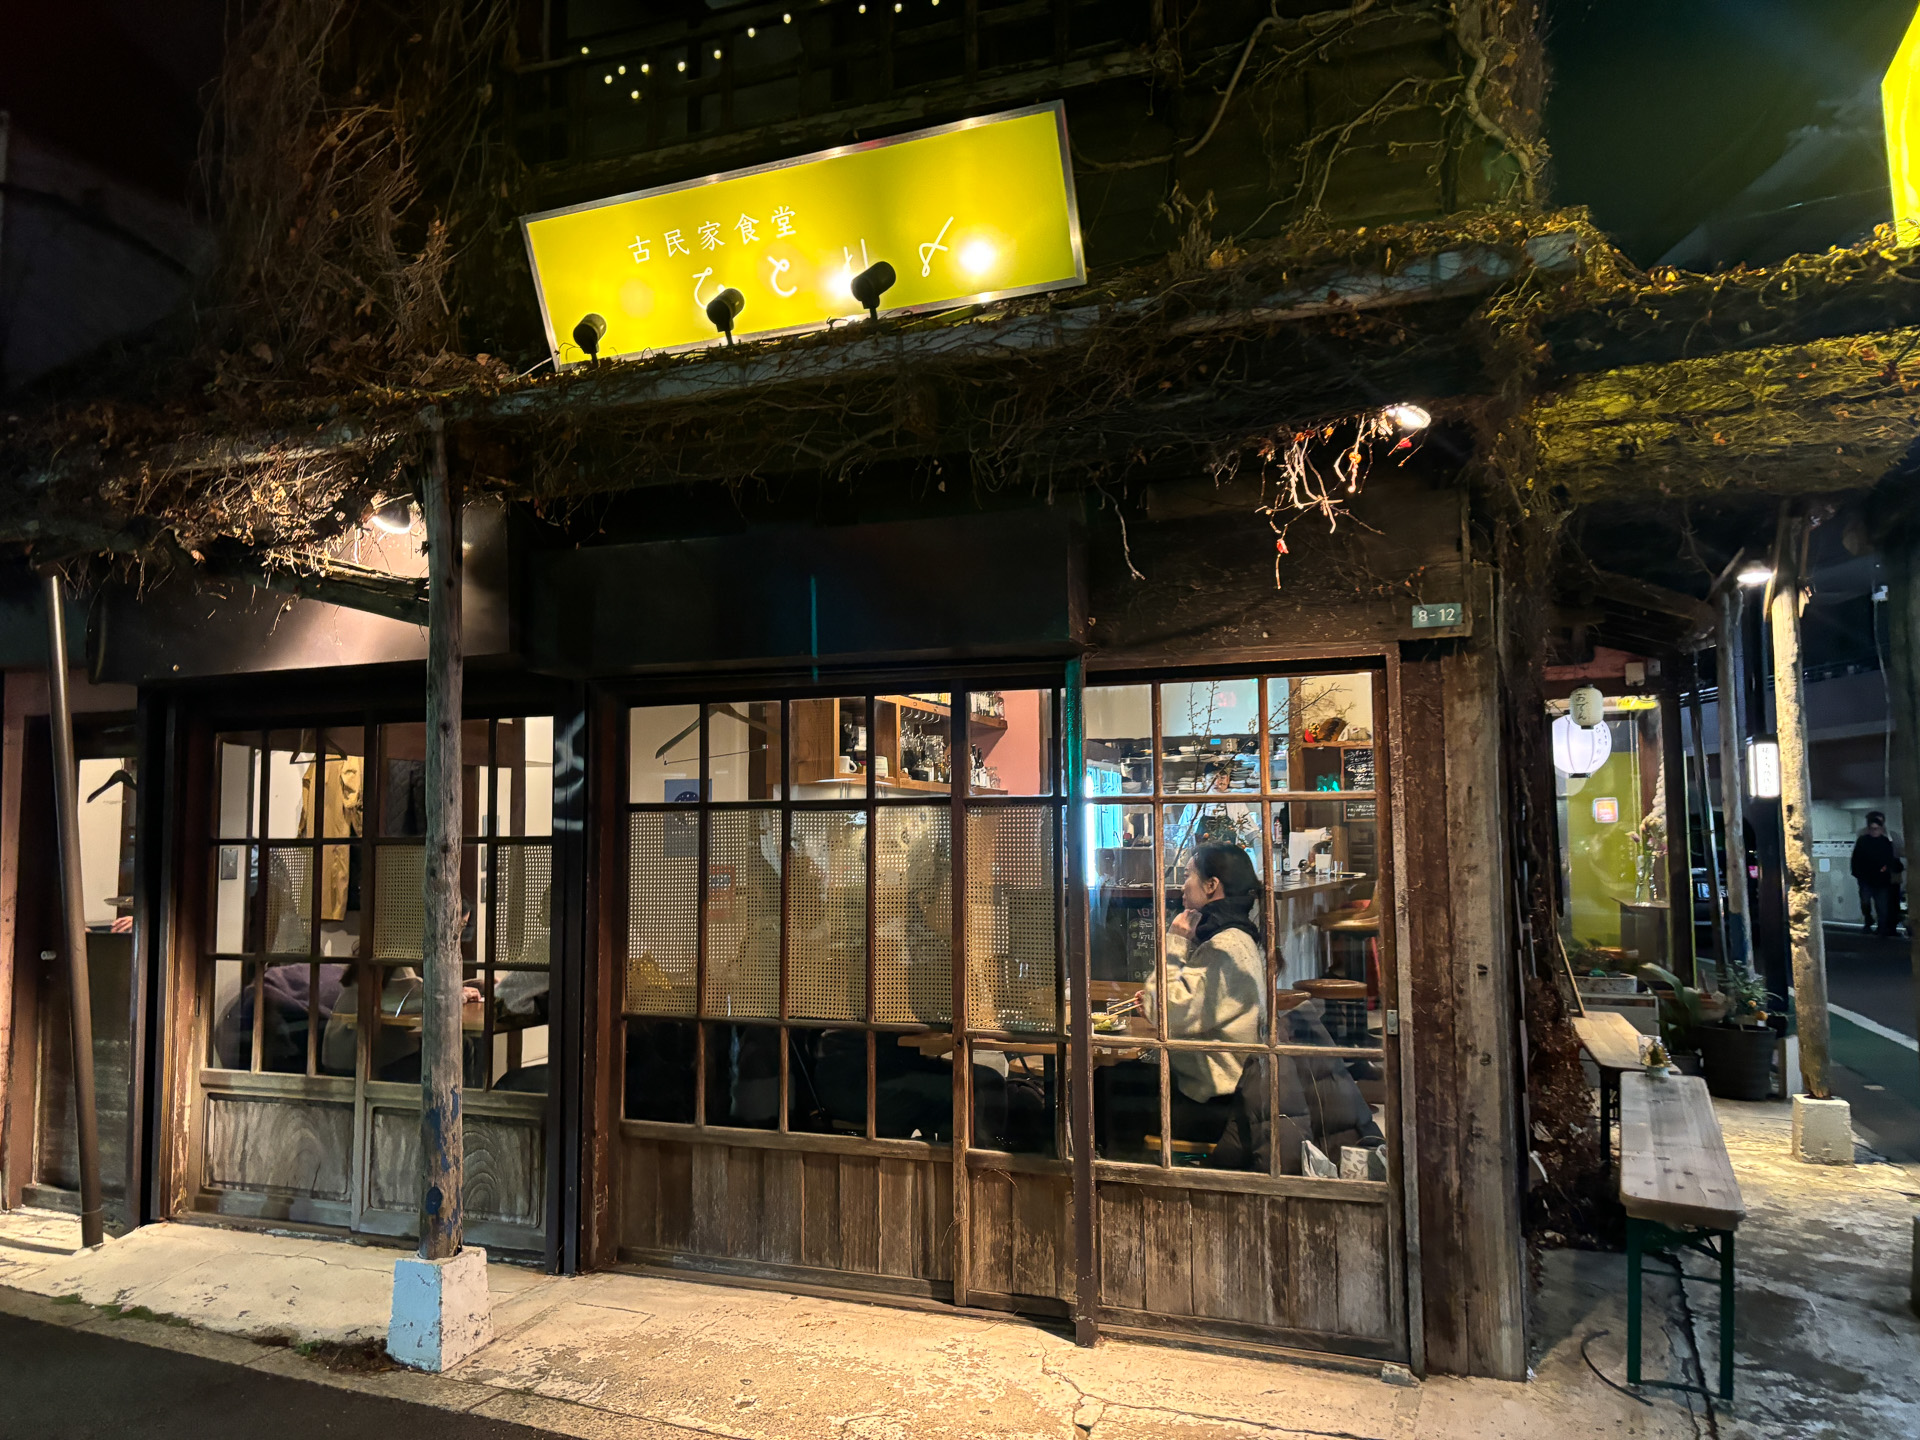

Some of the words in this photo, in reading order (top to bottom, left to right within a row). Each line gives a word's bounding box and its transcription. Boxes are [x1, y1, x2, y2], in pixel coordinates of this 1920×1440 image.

[627, 205, 797, 264] 古民家食堂
[1418, 608, 1455, 622] 8-12
